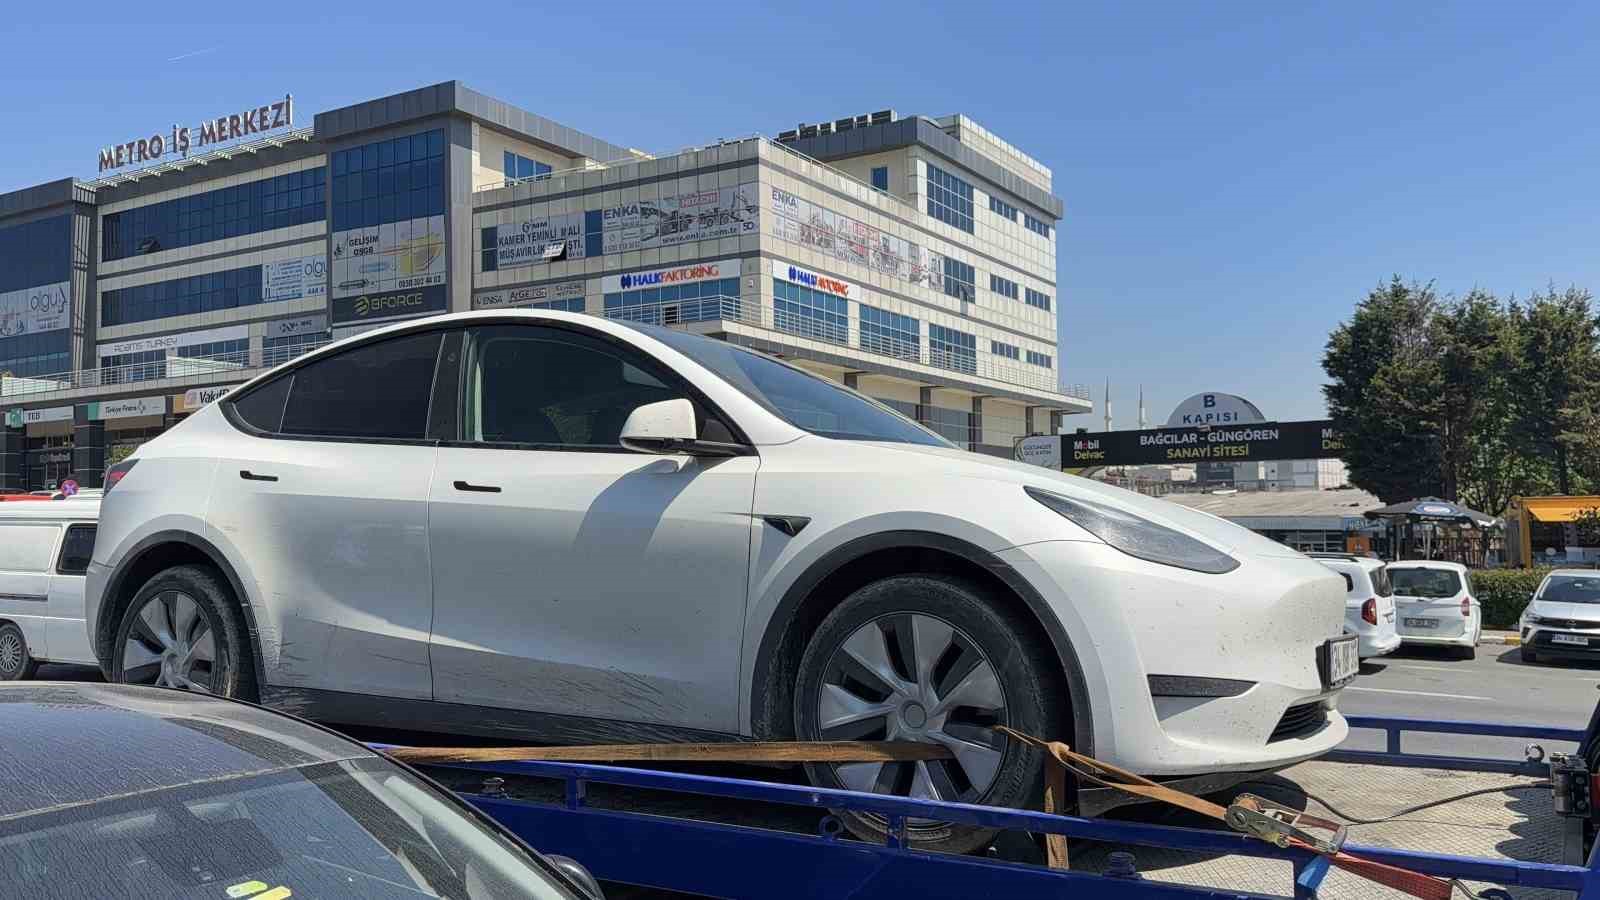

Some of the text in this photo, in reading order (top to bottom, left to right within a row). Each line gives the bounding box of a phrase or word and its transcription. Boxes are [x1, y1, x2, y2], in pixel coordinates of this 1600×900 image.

[98, 93, 293, 172] METRO İŞ MERKEZİ
[604, 205, 639, 219] ENKA
[371, 293, 424, 311] BFORCE
[1203, 395, 1217, 409] B
[1183, 412, 1239, 424] KAPISI
[1140, 434, 1198, 446] BAĞCILAR
[1207, 428, 1279, 442] GÜNGÖREN
[1074, 439, 1100, 450] Mobil
[1166, 442, 1249, 459] SANAYİ SİTESİ
[1074, 450, 1104, 460] Delvac
